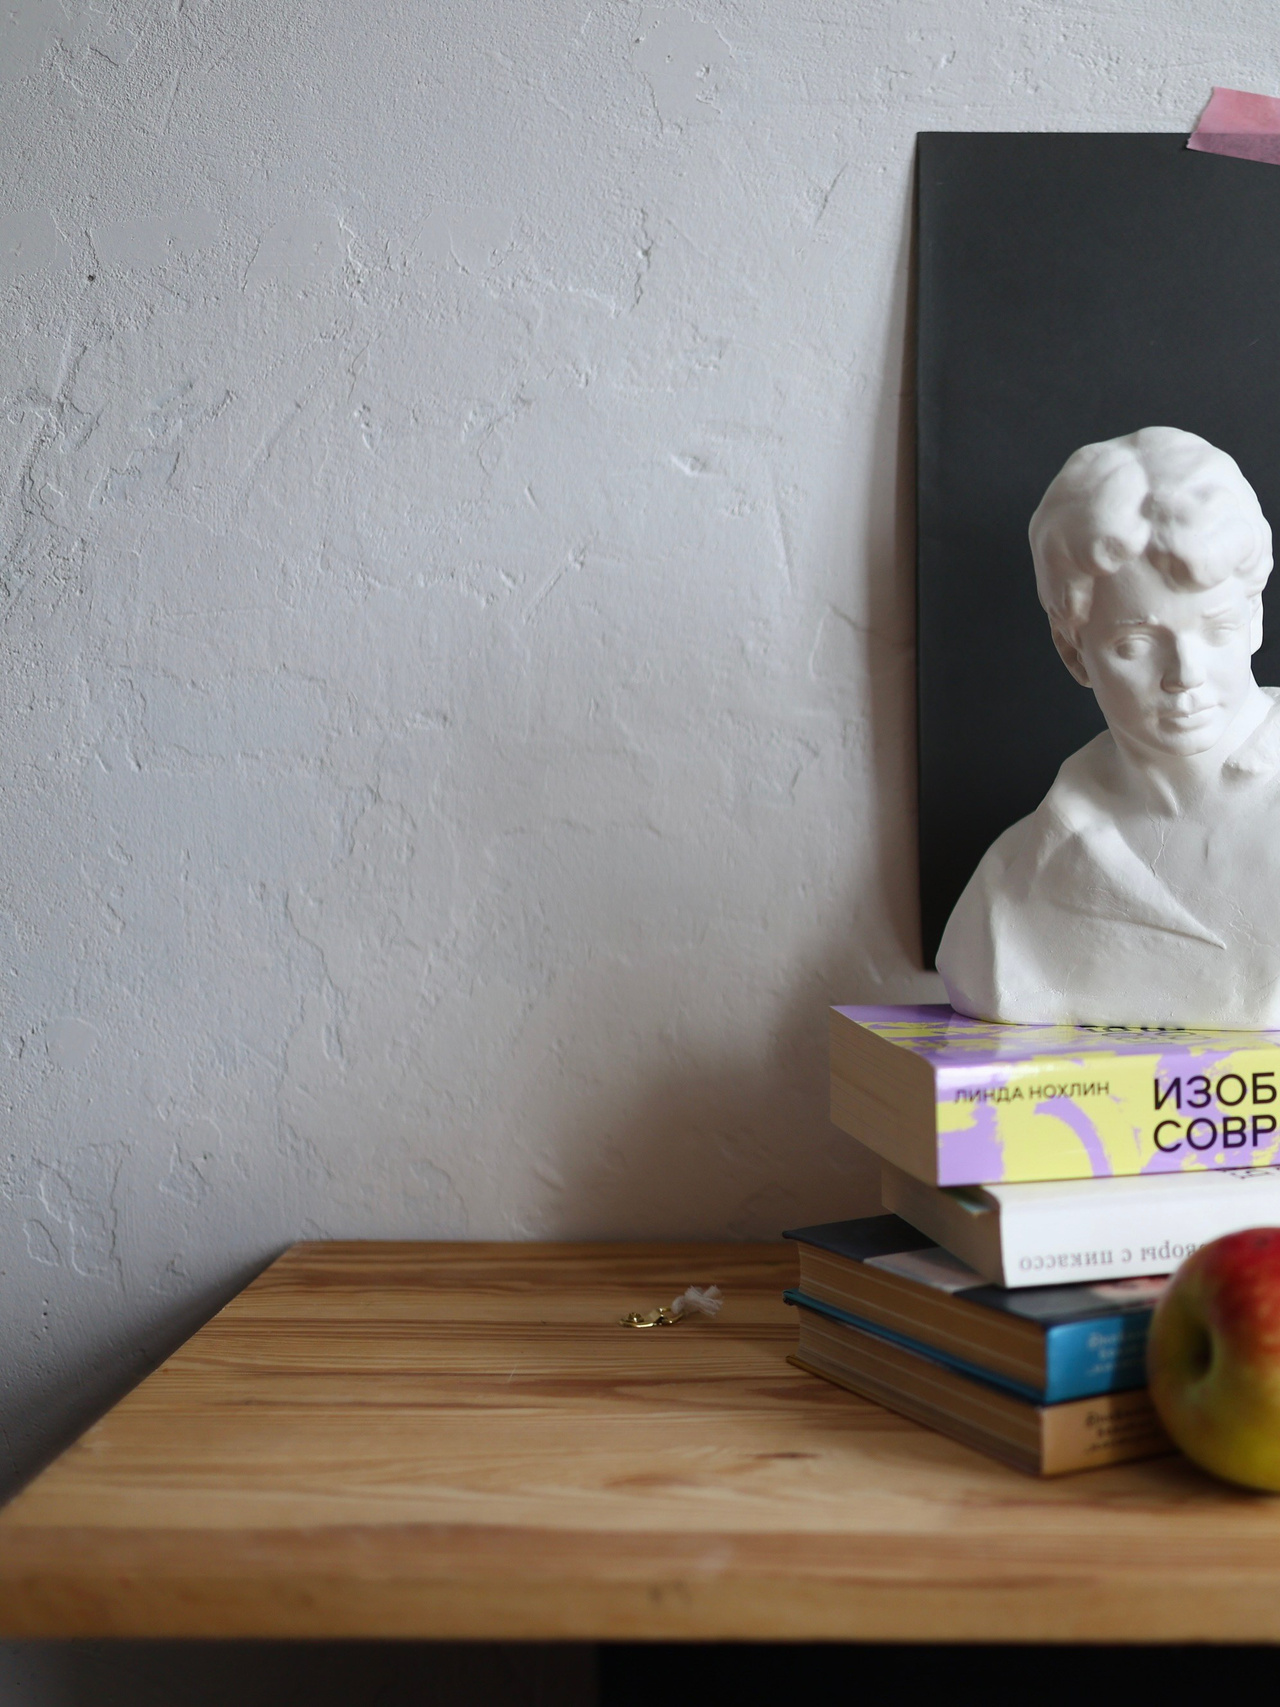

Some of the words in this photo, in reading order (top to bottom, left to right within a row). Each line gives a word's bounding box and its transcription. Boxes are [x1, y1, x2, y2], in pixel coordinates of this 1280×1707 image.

[955, 1086, 1024, 1105] ЛИНДА
[1029, 1081, 1109, 1100] НОХЛИН
[1019, 1251, 1114, 1271] пикассо
